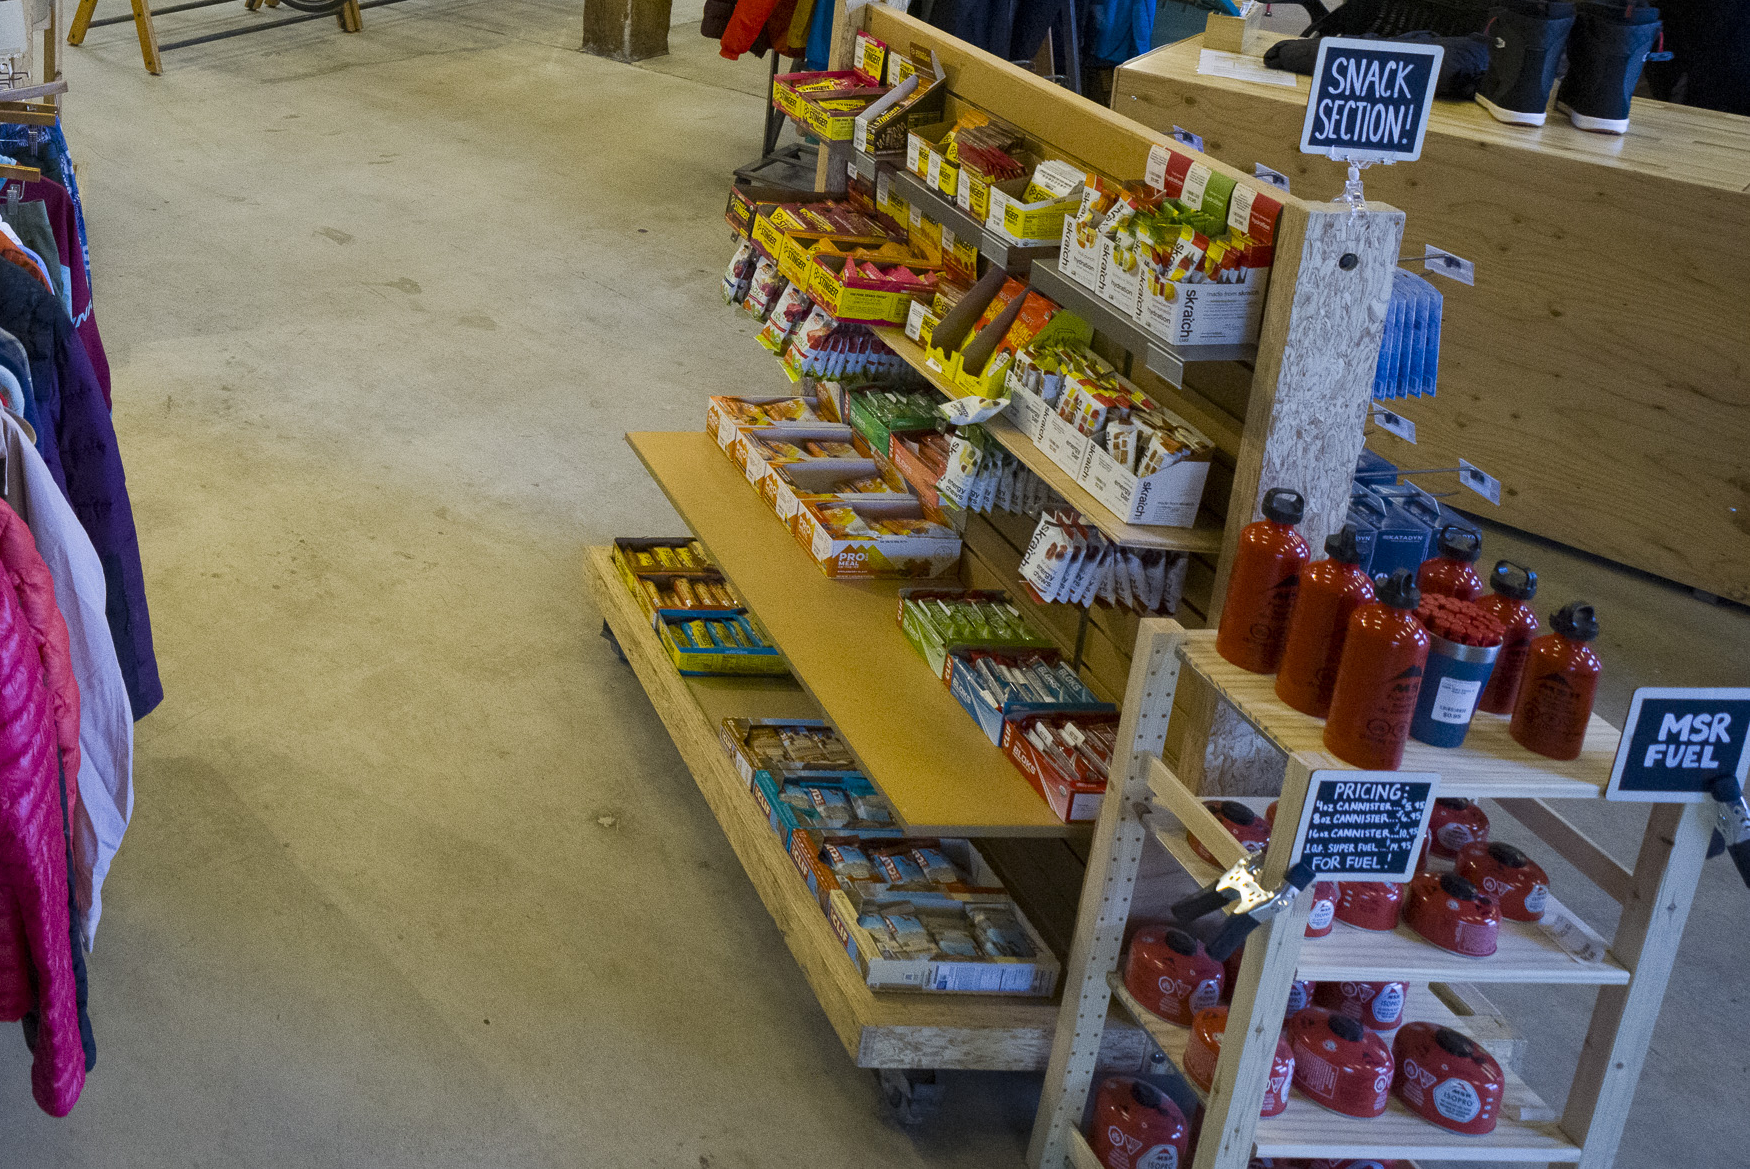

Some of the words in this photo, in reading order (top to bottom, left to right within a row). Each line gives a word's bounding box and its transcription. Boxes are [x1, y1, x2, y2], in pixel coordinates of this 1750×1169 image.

[1327, 56, 1415, 100] SNACK
[779, 91, 798, 107] STINGER
[809, 111, 828, 128] STINGER
[1315, 104, 1414, 145] SECTION!
[760, 228, 778, 246] STINGER
[1062, 220, 1073, 266] skratch
[787, 252, 806, 271] STINGER
[1073, 257, 1095, 272] hydration
[1099, 243, 1110, 290] skratch
[818, 275, 838, 296] STINGER
[1111, 280, 1133, 296] hydration
[1135, 269, 1146, 317] skratch
[1148, 307, 1171, 324] hydration
[1179, 289, 1196, 338] skratch
[1036, 407, 1049, 443] skratch
[1083, 443, 1095, 481] skratch
[1135, 482, 1151, 518] skratch
[1020, 524, 1050, 567] skratch
[1389, 533, 1425, 542] KATADYN
[838, 552, 865, 562] PRO
[1038, 665, 1060, 689] BLOKS
[1059, 667, 1081, 692] BLOKS
[953, 677, 972, 704] BLOKS
[1658, 711, 1732, 743] MSR
[1012, 745, 1036, 776] BLOKS
[1644, 744, 1719, 769] FUEL
[1334, 783, 1410, 800] PRICING:
[1316, 800, 1333, 811] 4oz
[1313, 814, 1331, 824] 8oz
[1308, 829, 1329, 839] 16oz
[1328, 843, 1354, 853] SUPER
[1312, 857, 1341, 871] FOR
[1444, 1096, 1473, 1108] ISOPRO
[1452, 1089, 1472, 1098] MSR
